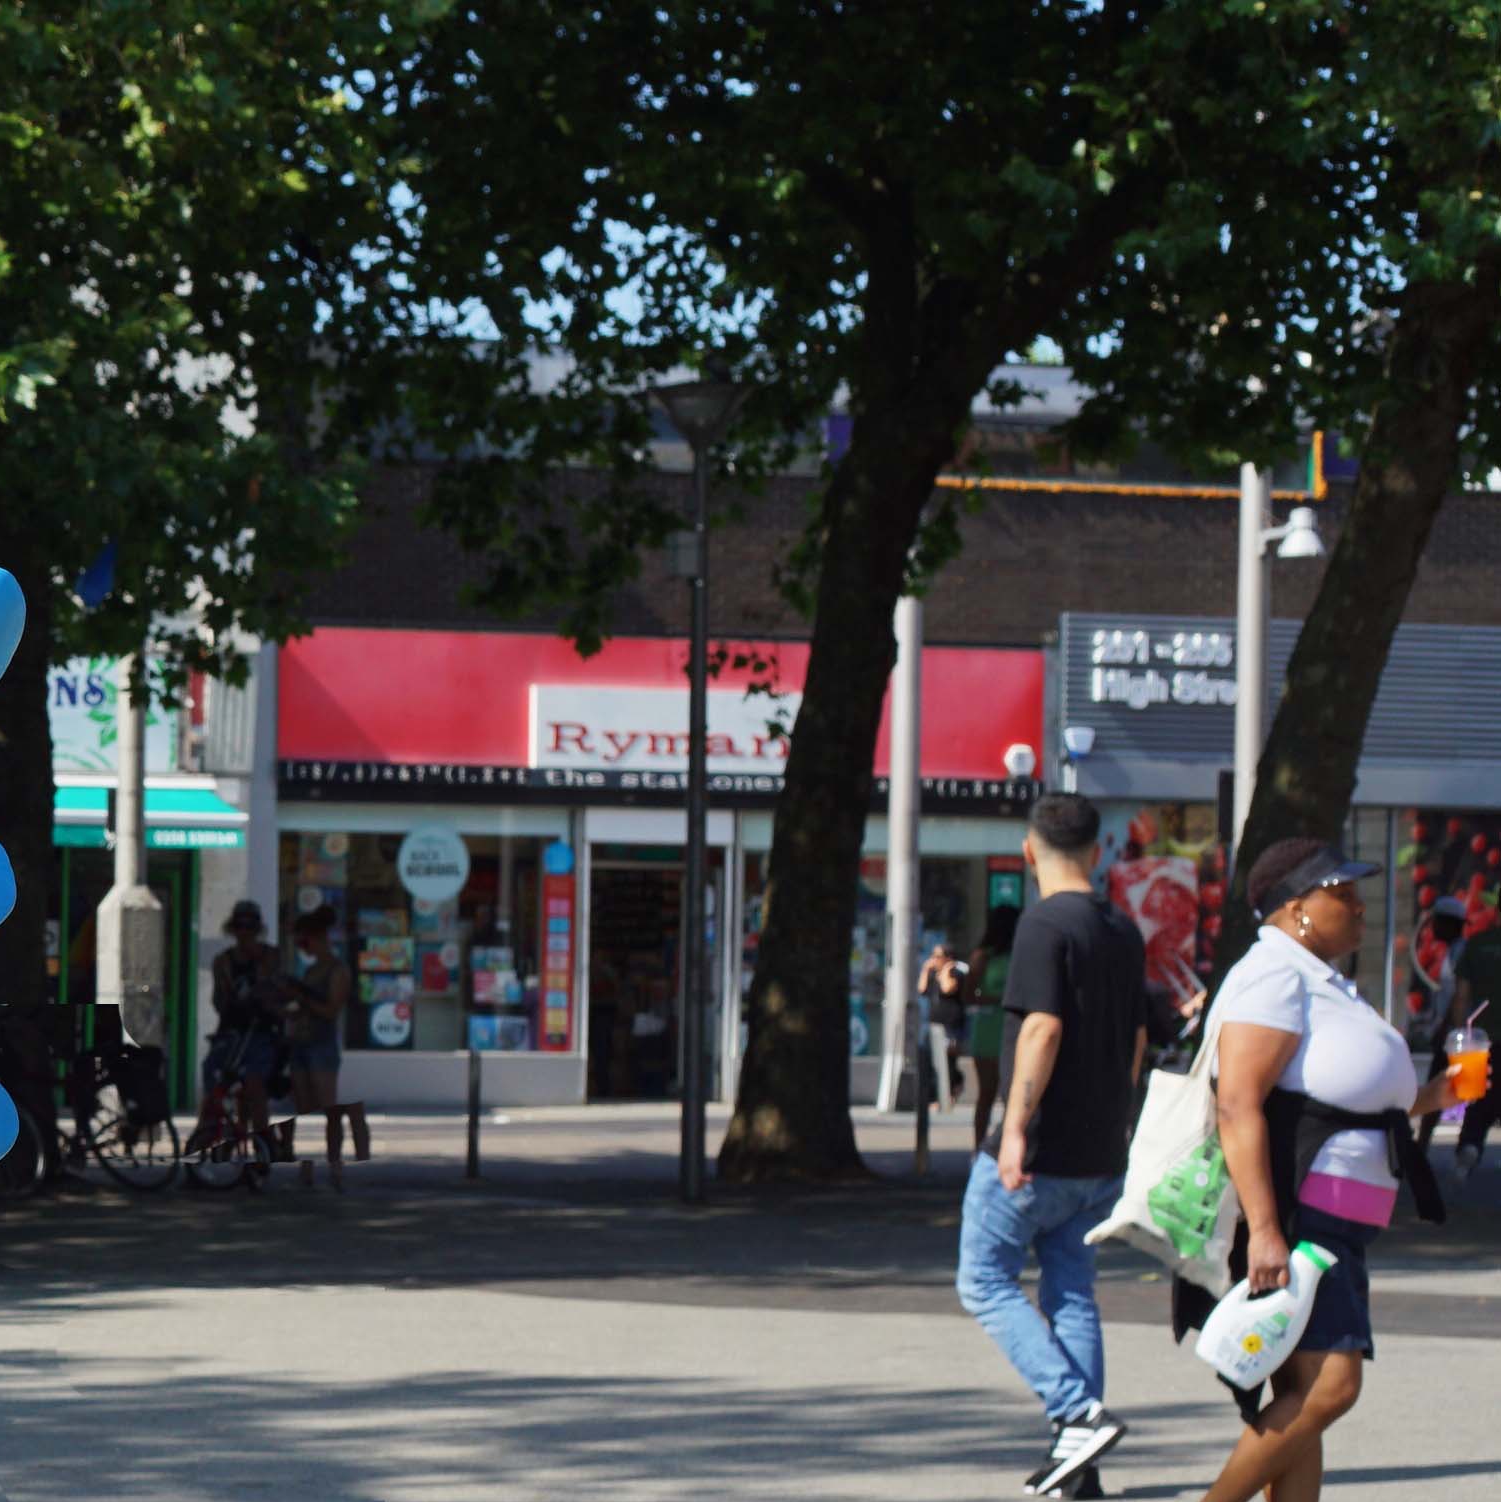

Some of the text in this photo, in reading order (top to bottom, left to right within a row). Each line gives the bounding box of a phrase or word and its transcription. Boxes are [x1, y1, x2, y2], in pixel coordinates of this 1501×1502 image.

[1172, 671, 1237, 705] Stre
[547, 721, 791, 763] Ryman
[546, 769, 606, 787] the
[620, 771, 786, 793] statoner
